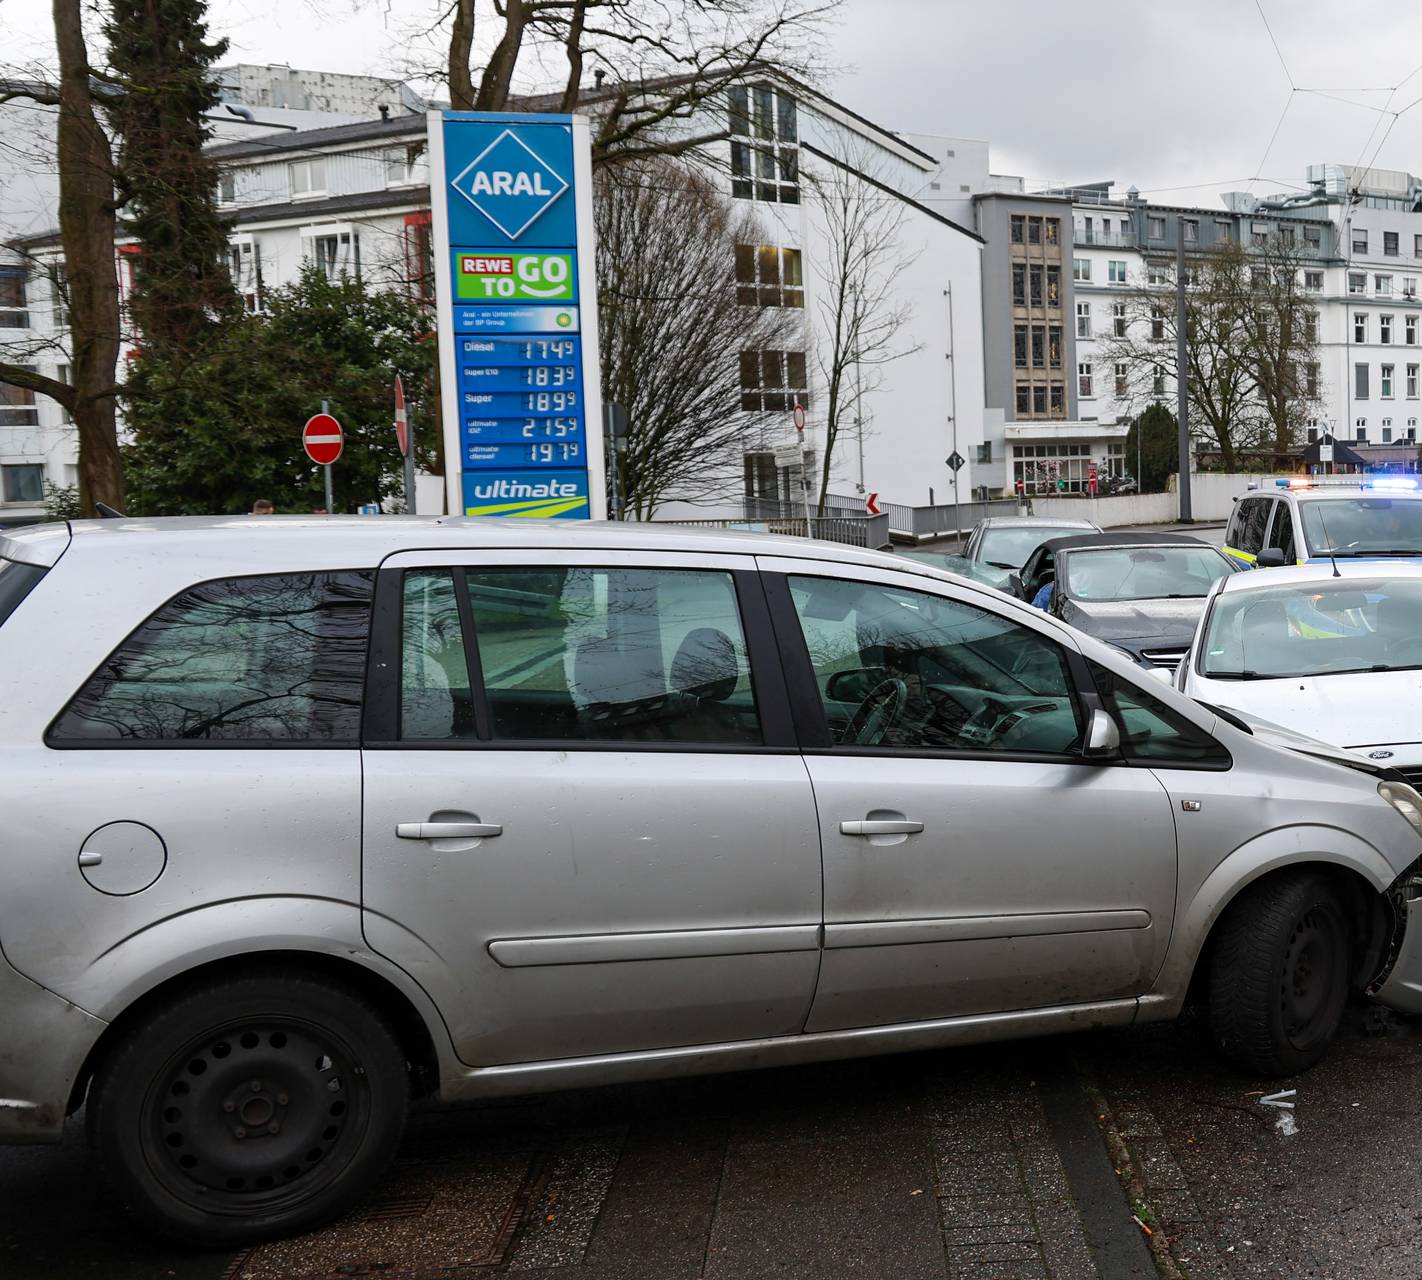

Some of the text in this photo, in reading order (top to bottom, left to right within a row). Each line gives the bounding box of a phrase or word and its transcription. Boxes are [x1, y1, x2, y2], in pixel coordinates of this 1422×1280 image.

[471, 171, 551, 196] ARAL
[463, 258, 511, 273] REWE
[517, 256, 567, 283] GO
[481, 278, 515, 297] TO
[486, 319, 505, 327] Group
[464, 342, 494, 352] Diesel
[464, 369, 483, 377] Super
[465, 394, 492, 404] Super
[469, 452, 495, 460] diesel
[475, 479, 577, 499] ultimate
